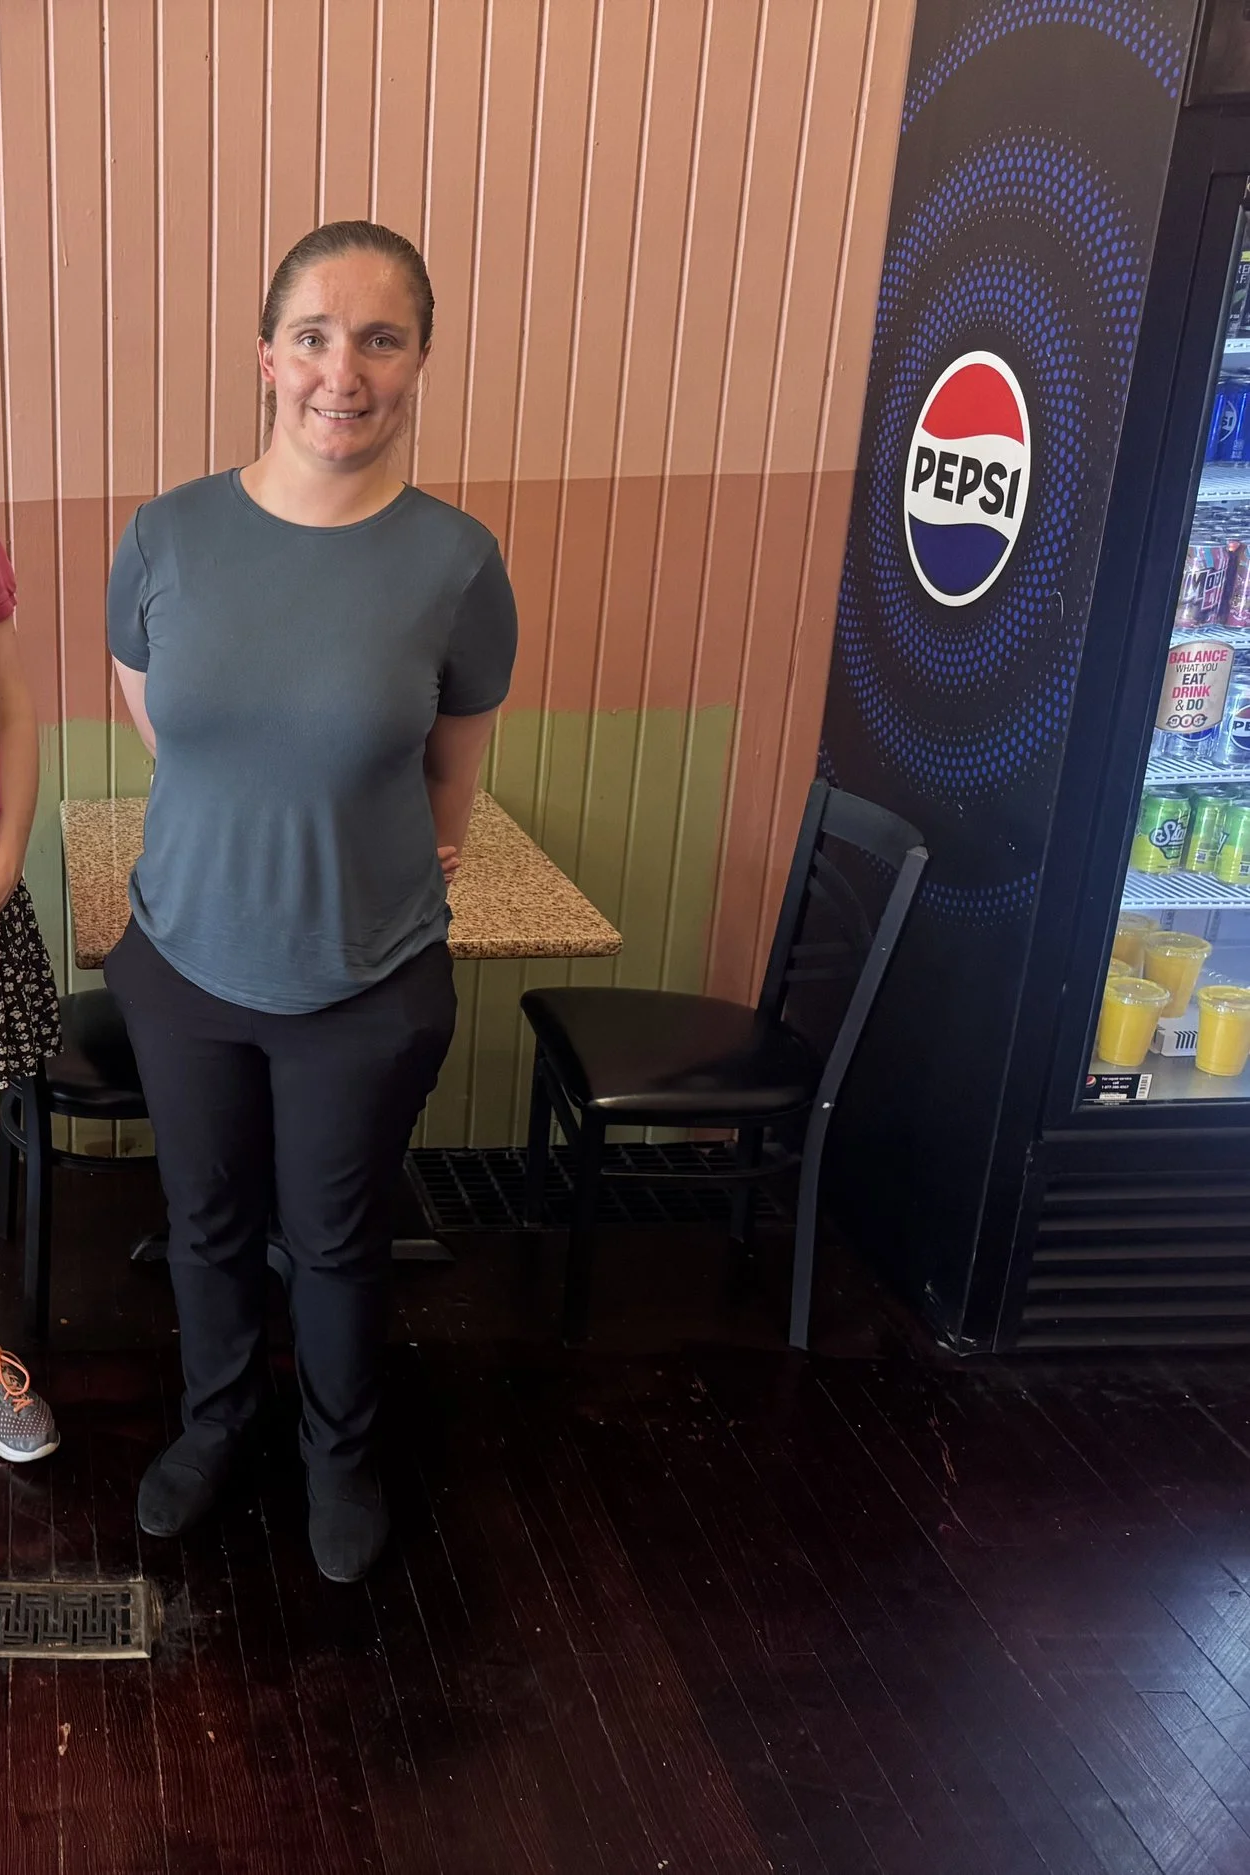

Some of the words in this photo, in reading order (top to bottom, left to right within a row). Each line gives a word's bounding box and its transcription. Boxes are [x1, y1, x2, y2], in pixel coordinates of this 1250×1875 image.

[911, 445, 1022, 520] PEPSI
[1169, 649, 1229, 664] BALANCE
[1175, 663, 1199, 673] WHAT
[1201, 662, 1218, 672] YOU
[1171, 685, 1212, 699] DRINK
[1175, 699, 1184, 711] &
[1186, 698, 1204, 711] DO
